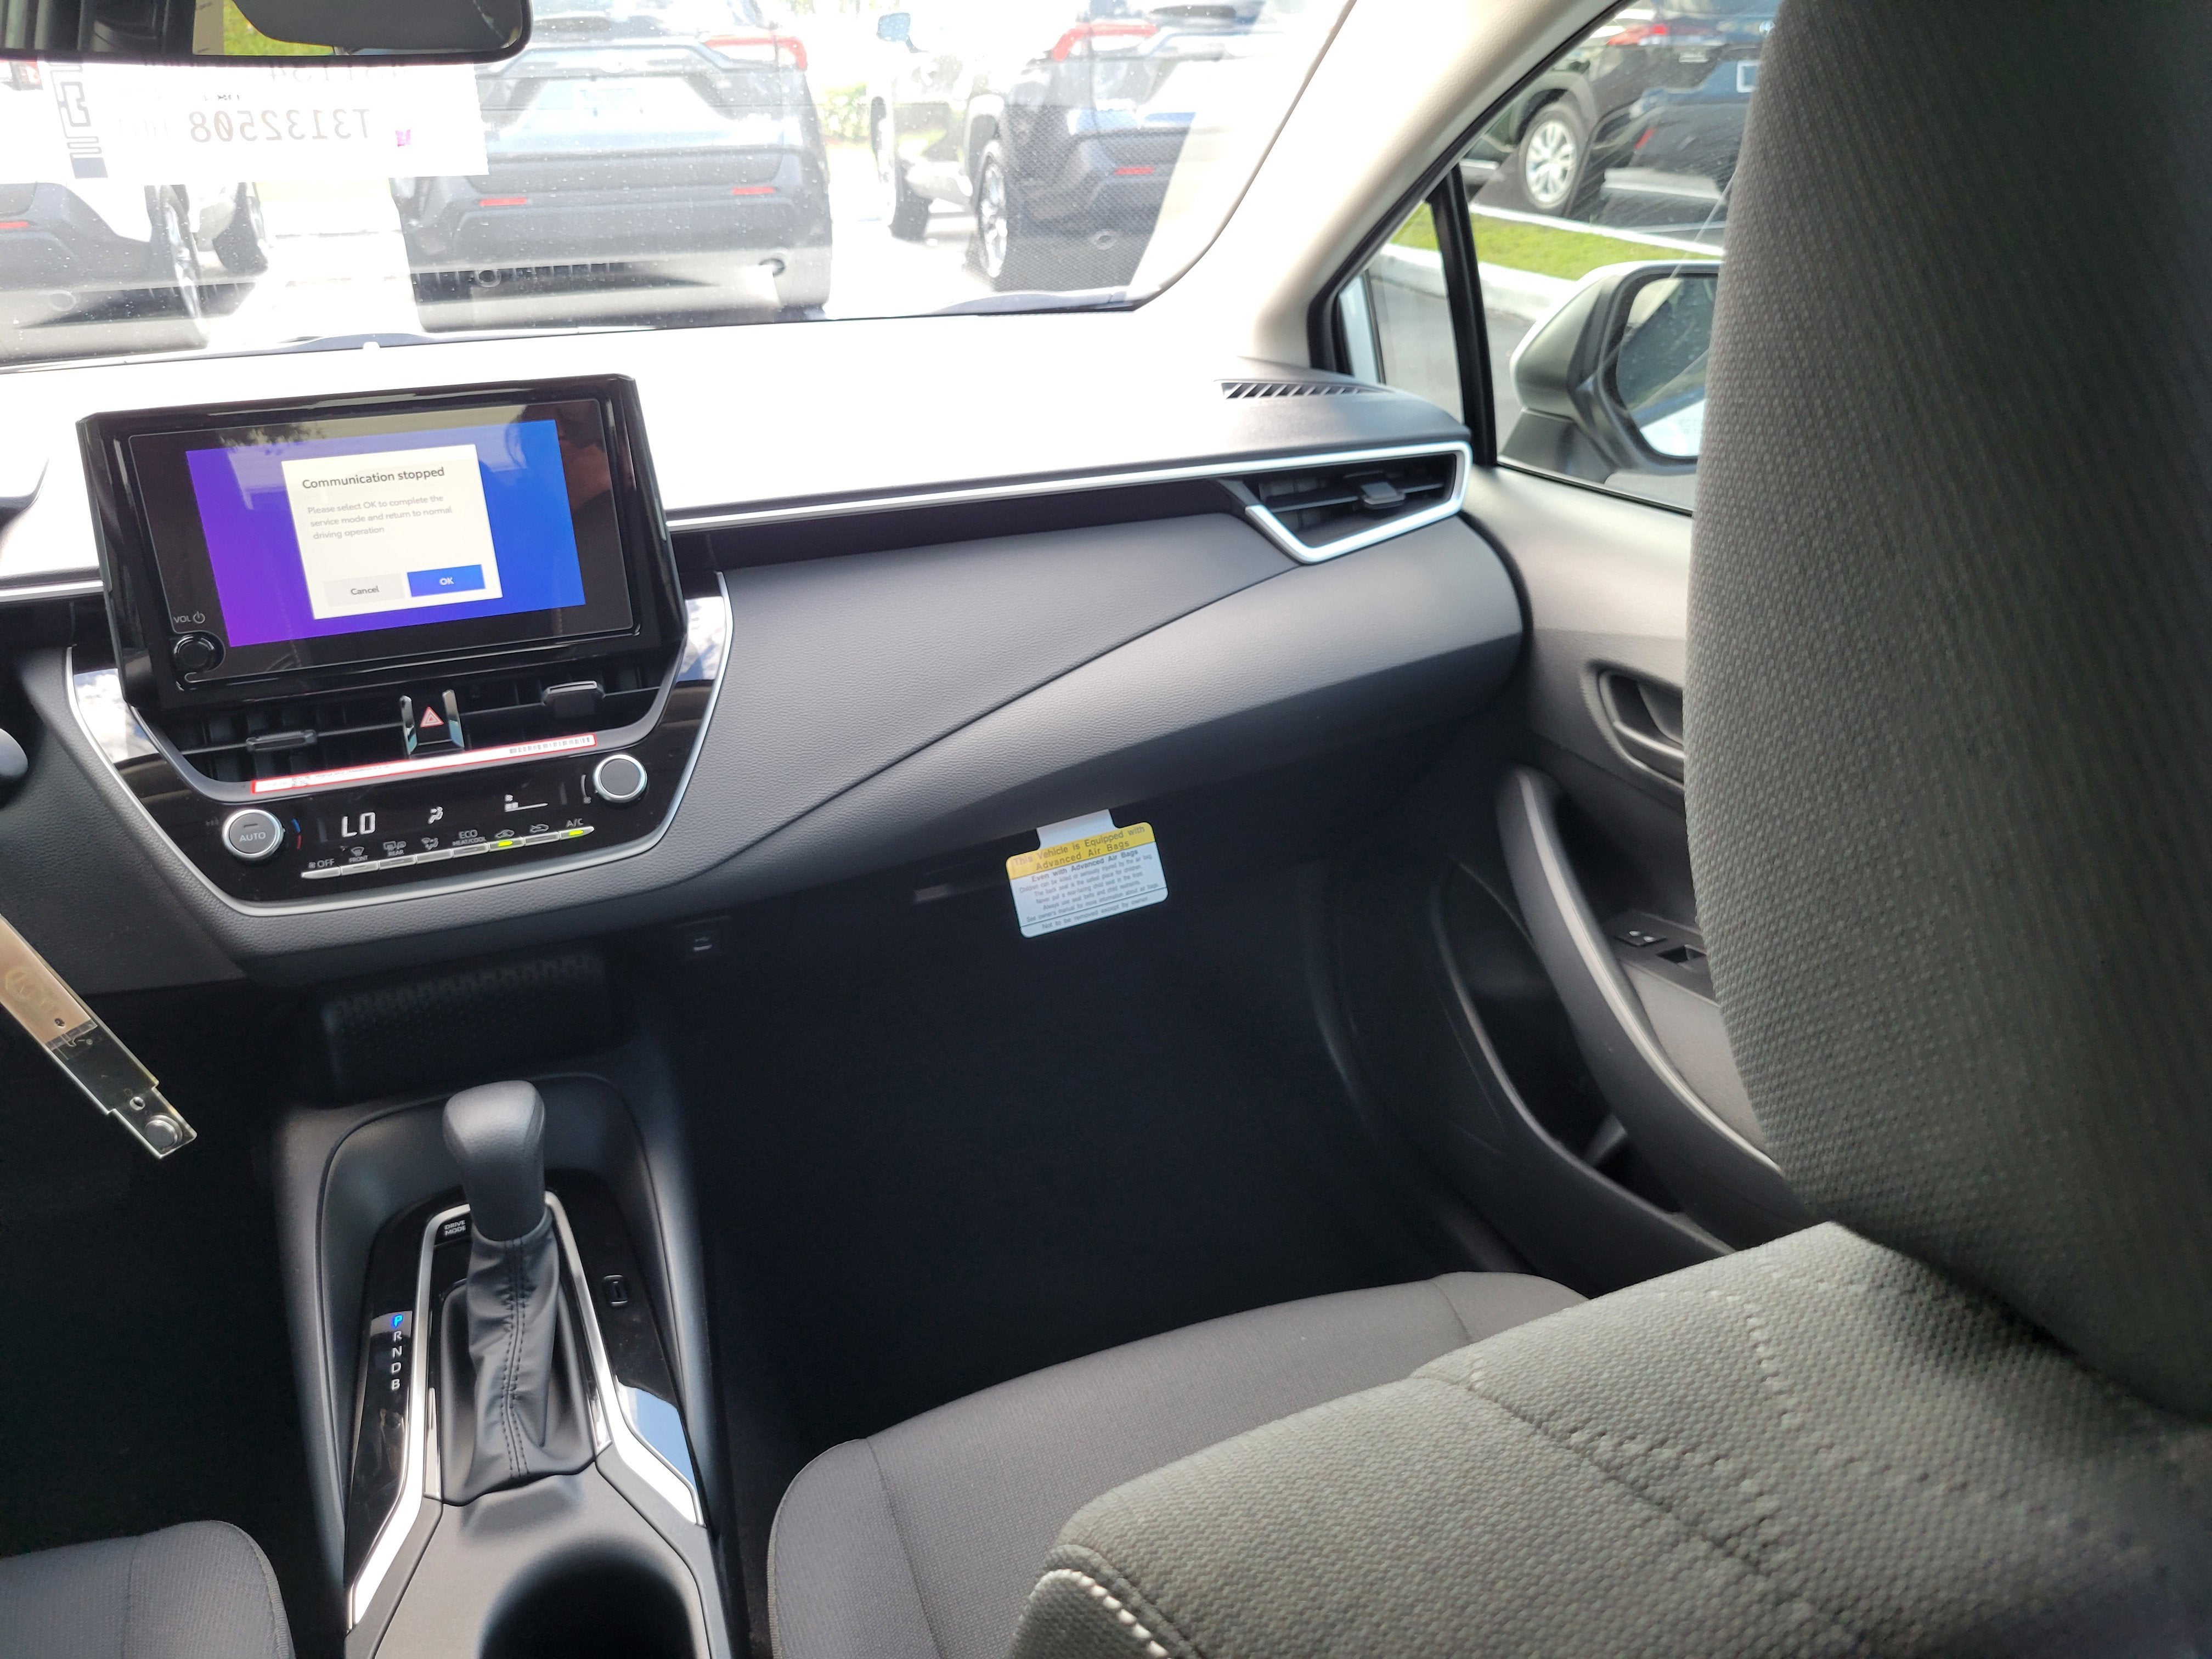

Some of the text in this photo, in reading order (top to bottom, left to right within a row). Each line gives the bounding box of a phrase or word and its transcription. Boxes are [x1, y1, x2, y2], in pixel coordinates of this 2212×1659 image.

[302, 466, 445, 489] Communication stopped
[307, 494, 444, 515] Please select OK to complete the
[311, 506, 453, 527] service mode and return to normal
[313, 526, 385, 540] driving operation
[439, 576, 454, 586] OK
[351, 585, 380, 596] Cancel
[341, 812, 376, 838] LO
[566, 818, 584, 827] A/C
[240, 832, 266, 842] AUTO
[459, 829, 478, 839] ECO
[1013, 856, 1033, 865] This
[1037, 846, 1068, 859] Vehicle
[1084, 831, 1124, 847] Equipped
[1127, 826, 1145, 835] with
[348, 855, 369, 863] FRONT
[1036, 841, 1129, 870] Advanced Air Bags
[1071, 858, 1105, 872] Advanced
[1121, 850, 1138, 858] Bags
[317, 859, 335, 868] OFF
[444, 1220, 466, 1229] DRIVE
[444, 1225, 466, 1236] MODE
[393, 1314, 403, 1328] P
[393, 1330, 403, 1342] R
[392, 1346, 402, 1358] N
[392, 1362, 400, 1374] D
[391, 1378, 400, 1391] B
